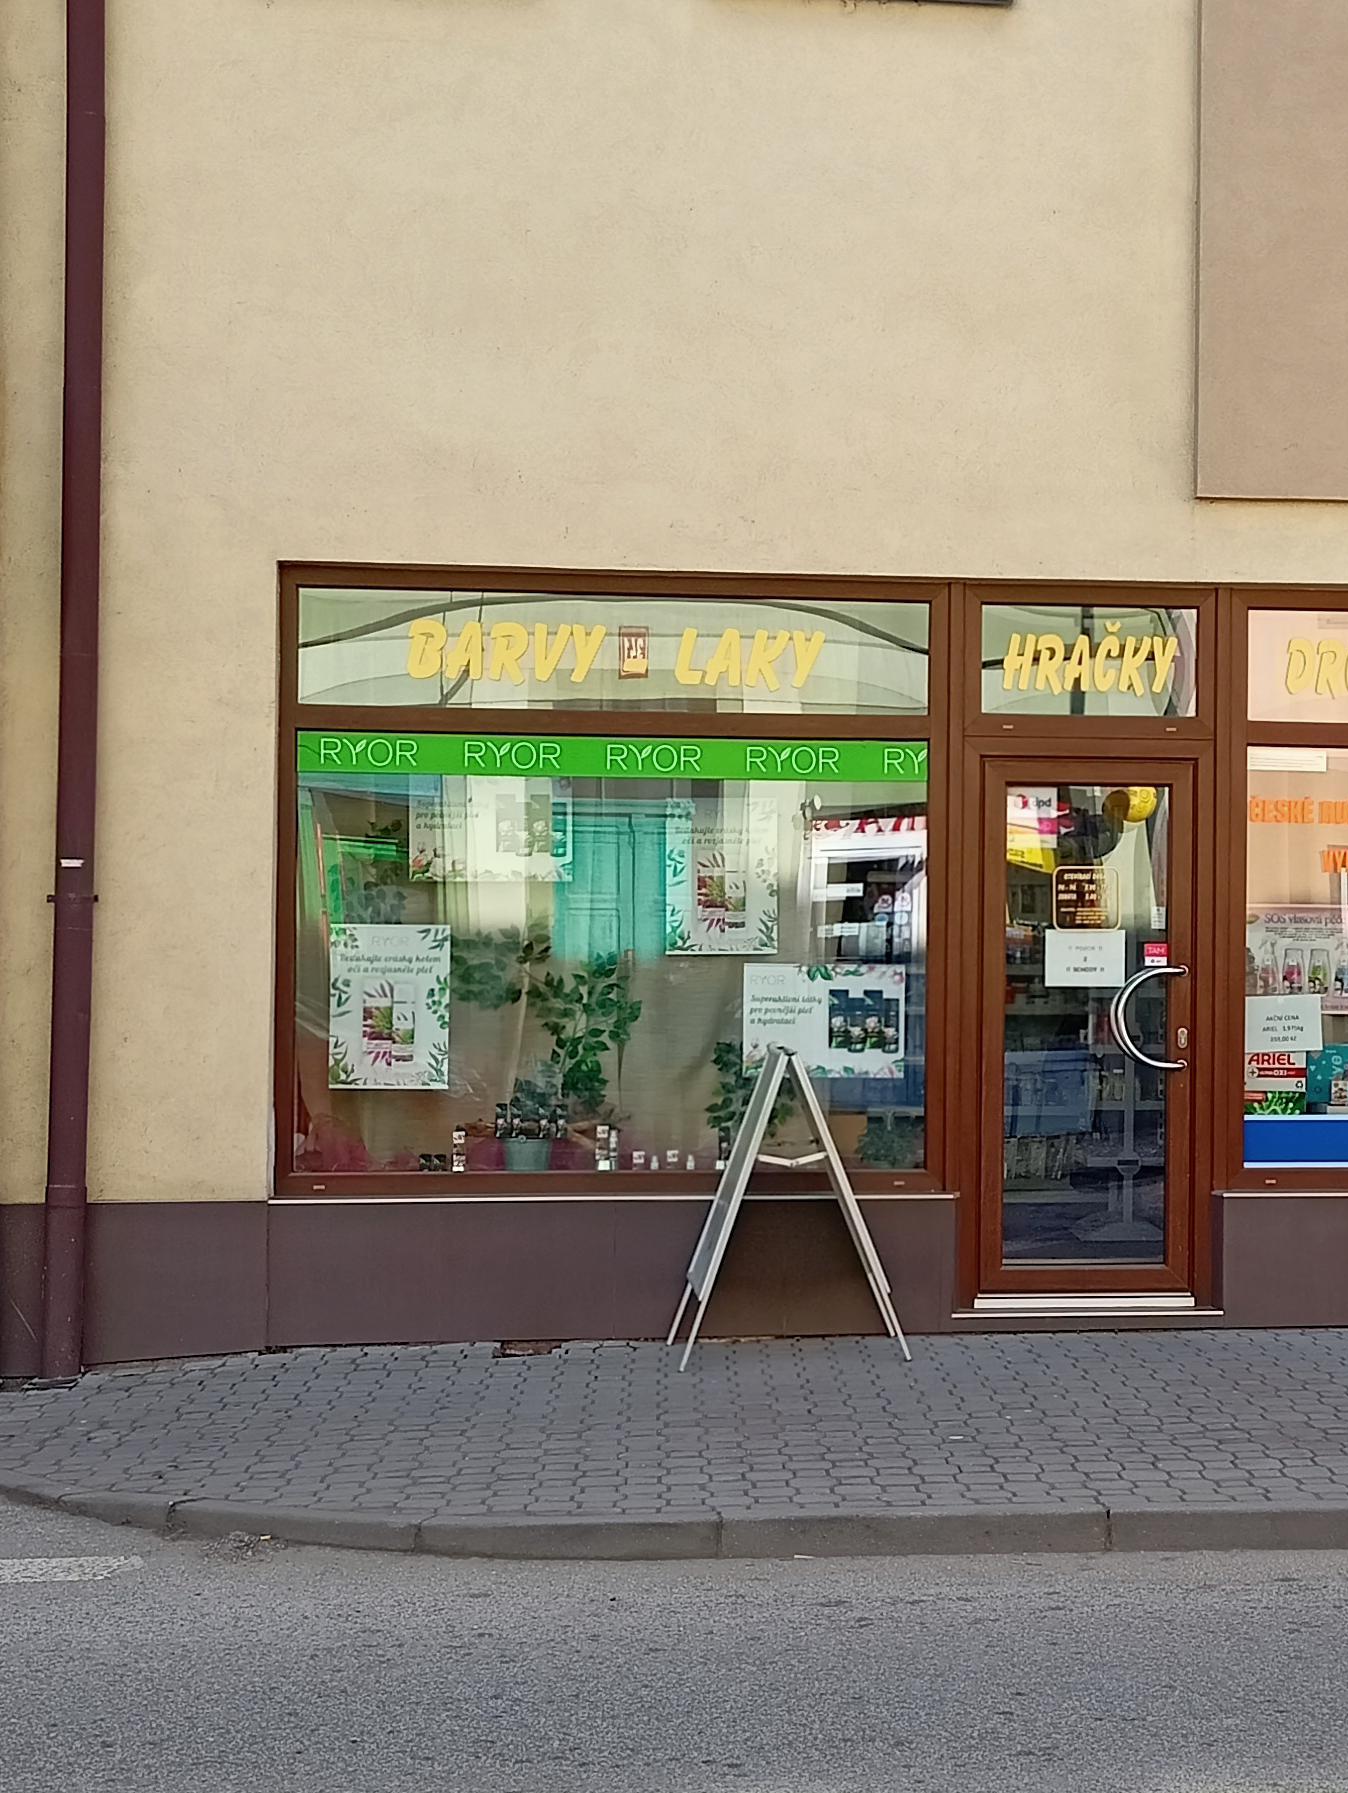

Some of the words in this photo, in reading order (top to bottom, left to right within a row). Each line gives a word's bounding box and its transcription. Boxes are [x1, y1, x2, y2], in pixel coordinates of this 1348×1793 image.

[407, 618, 608, 687] BARVY
[674, 627, 827, 694] LAKY
[1002, 620, 1179, 698] HRAČKY
[318, 737, 419, 768] RYOR
[463, 739, 562, 771] RYOR
[605, 743, 703, 774] RYOR
[744, 745, 841, 776] RYOR
[1248, 795, 1315, 824] ČESKÉ
[371, 935, 410, 948] RYOR
[750, 974, 786, 986] RYOR
[1247, 1053, 1297, 1066] ARIEL
